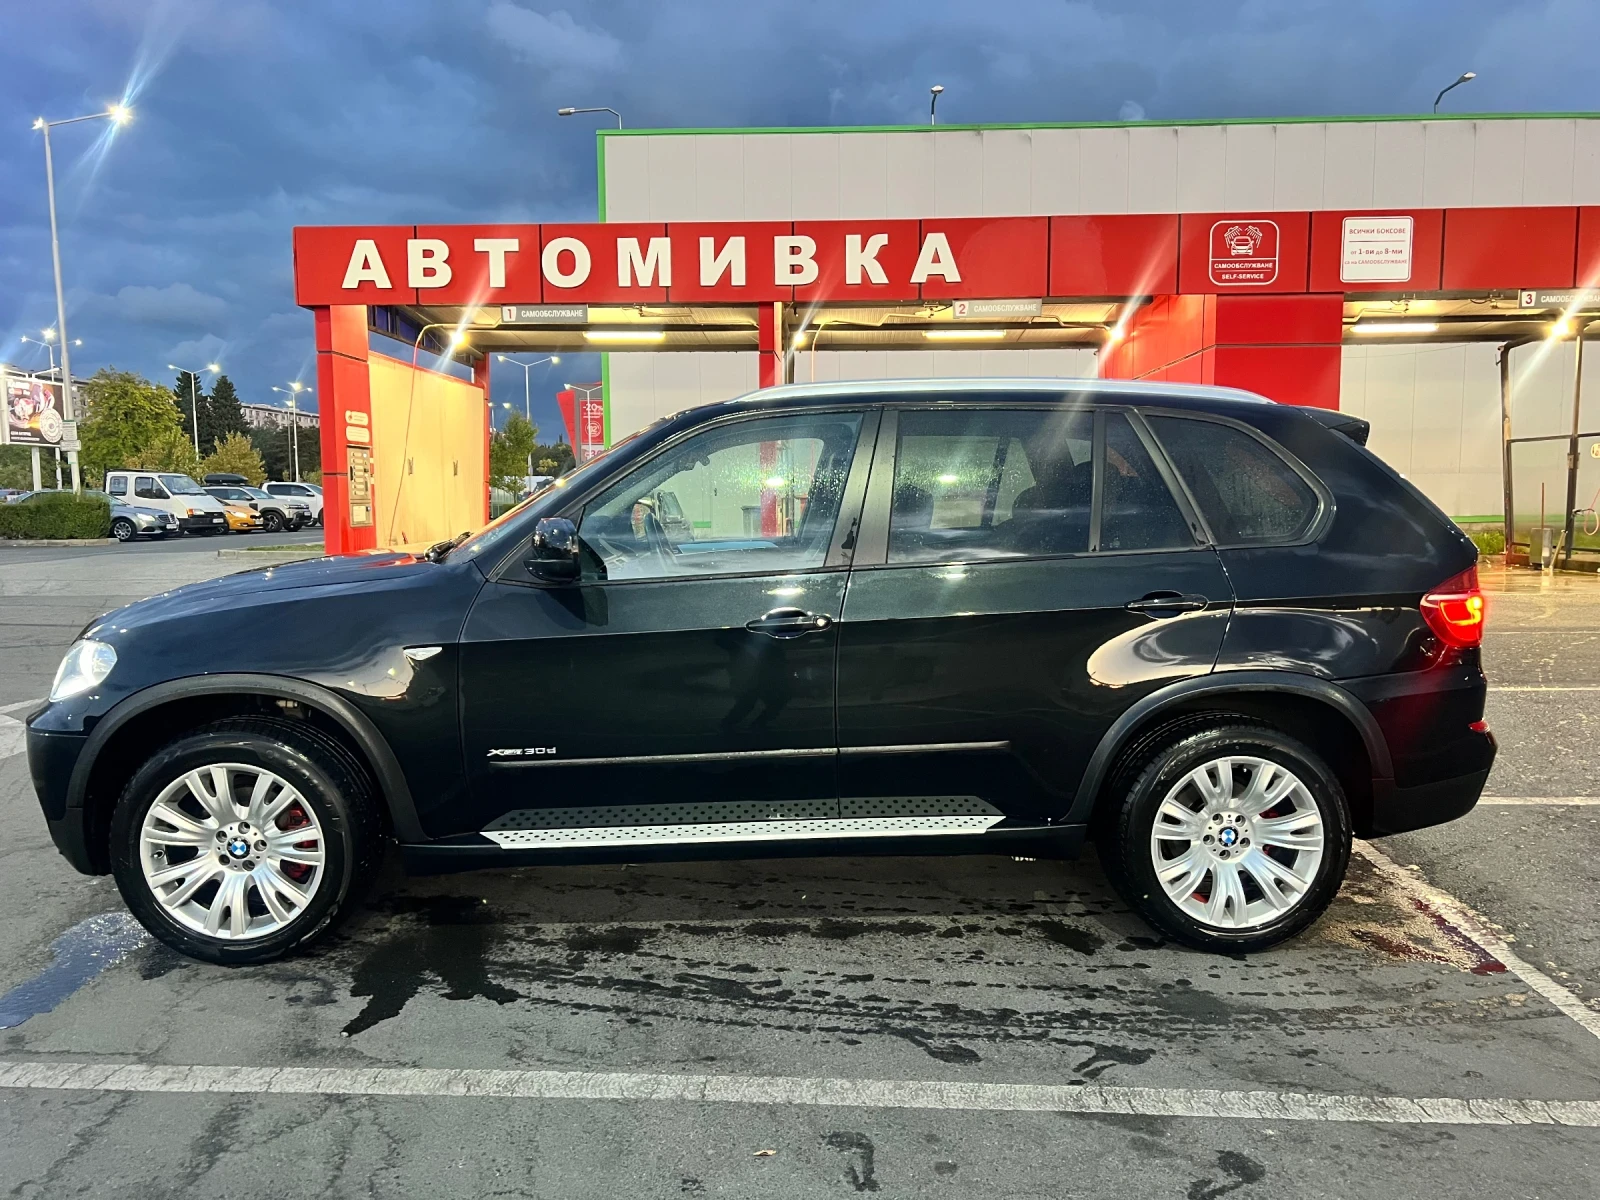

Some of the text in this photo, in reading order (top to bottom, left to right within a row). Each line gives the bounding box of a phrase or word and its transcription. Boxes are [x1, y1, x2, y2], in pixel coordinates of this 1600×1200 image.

[341, 232, 962, 289] АВТОМИВКА
[1525, 293, 1533, 305] 3
[521, 309, 583, 318] САМООБСЛУЖВАНЕ
[958, 303, 1037, 315] 2 САМООБСЛУЖВАНЕ
